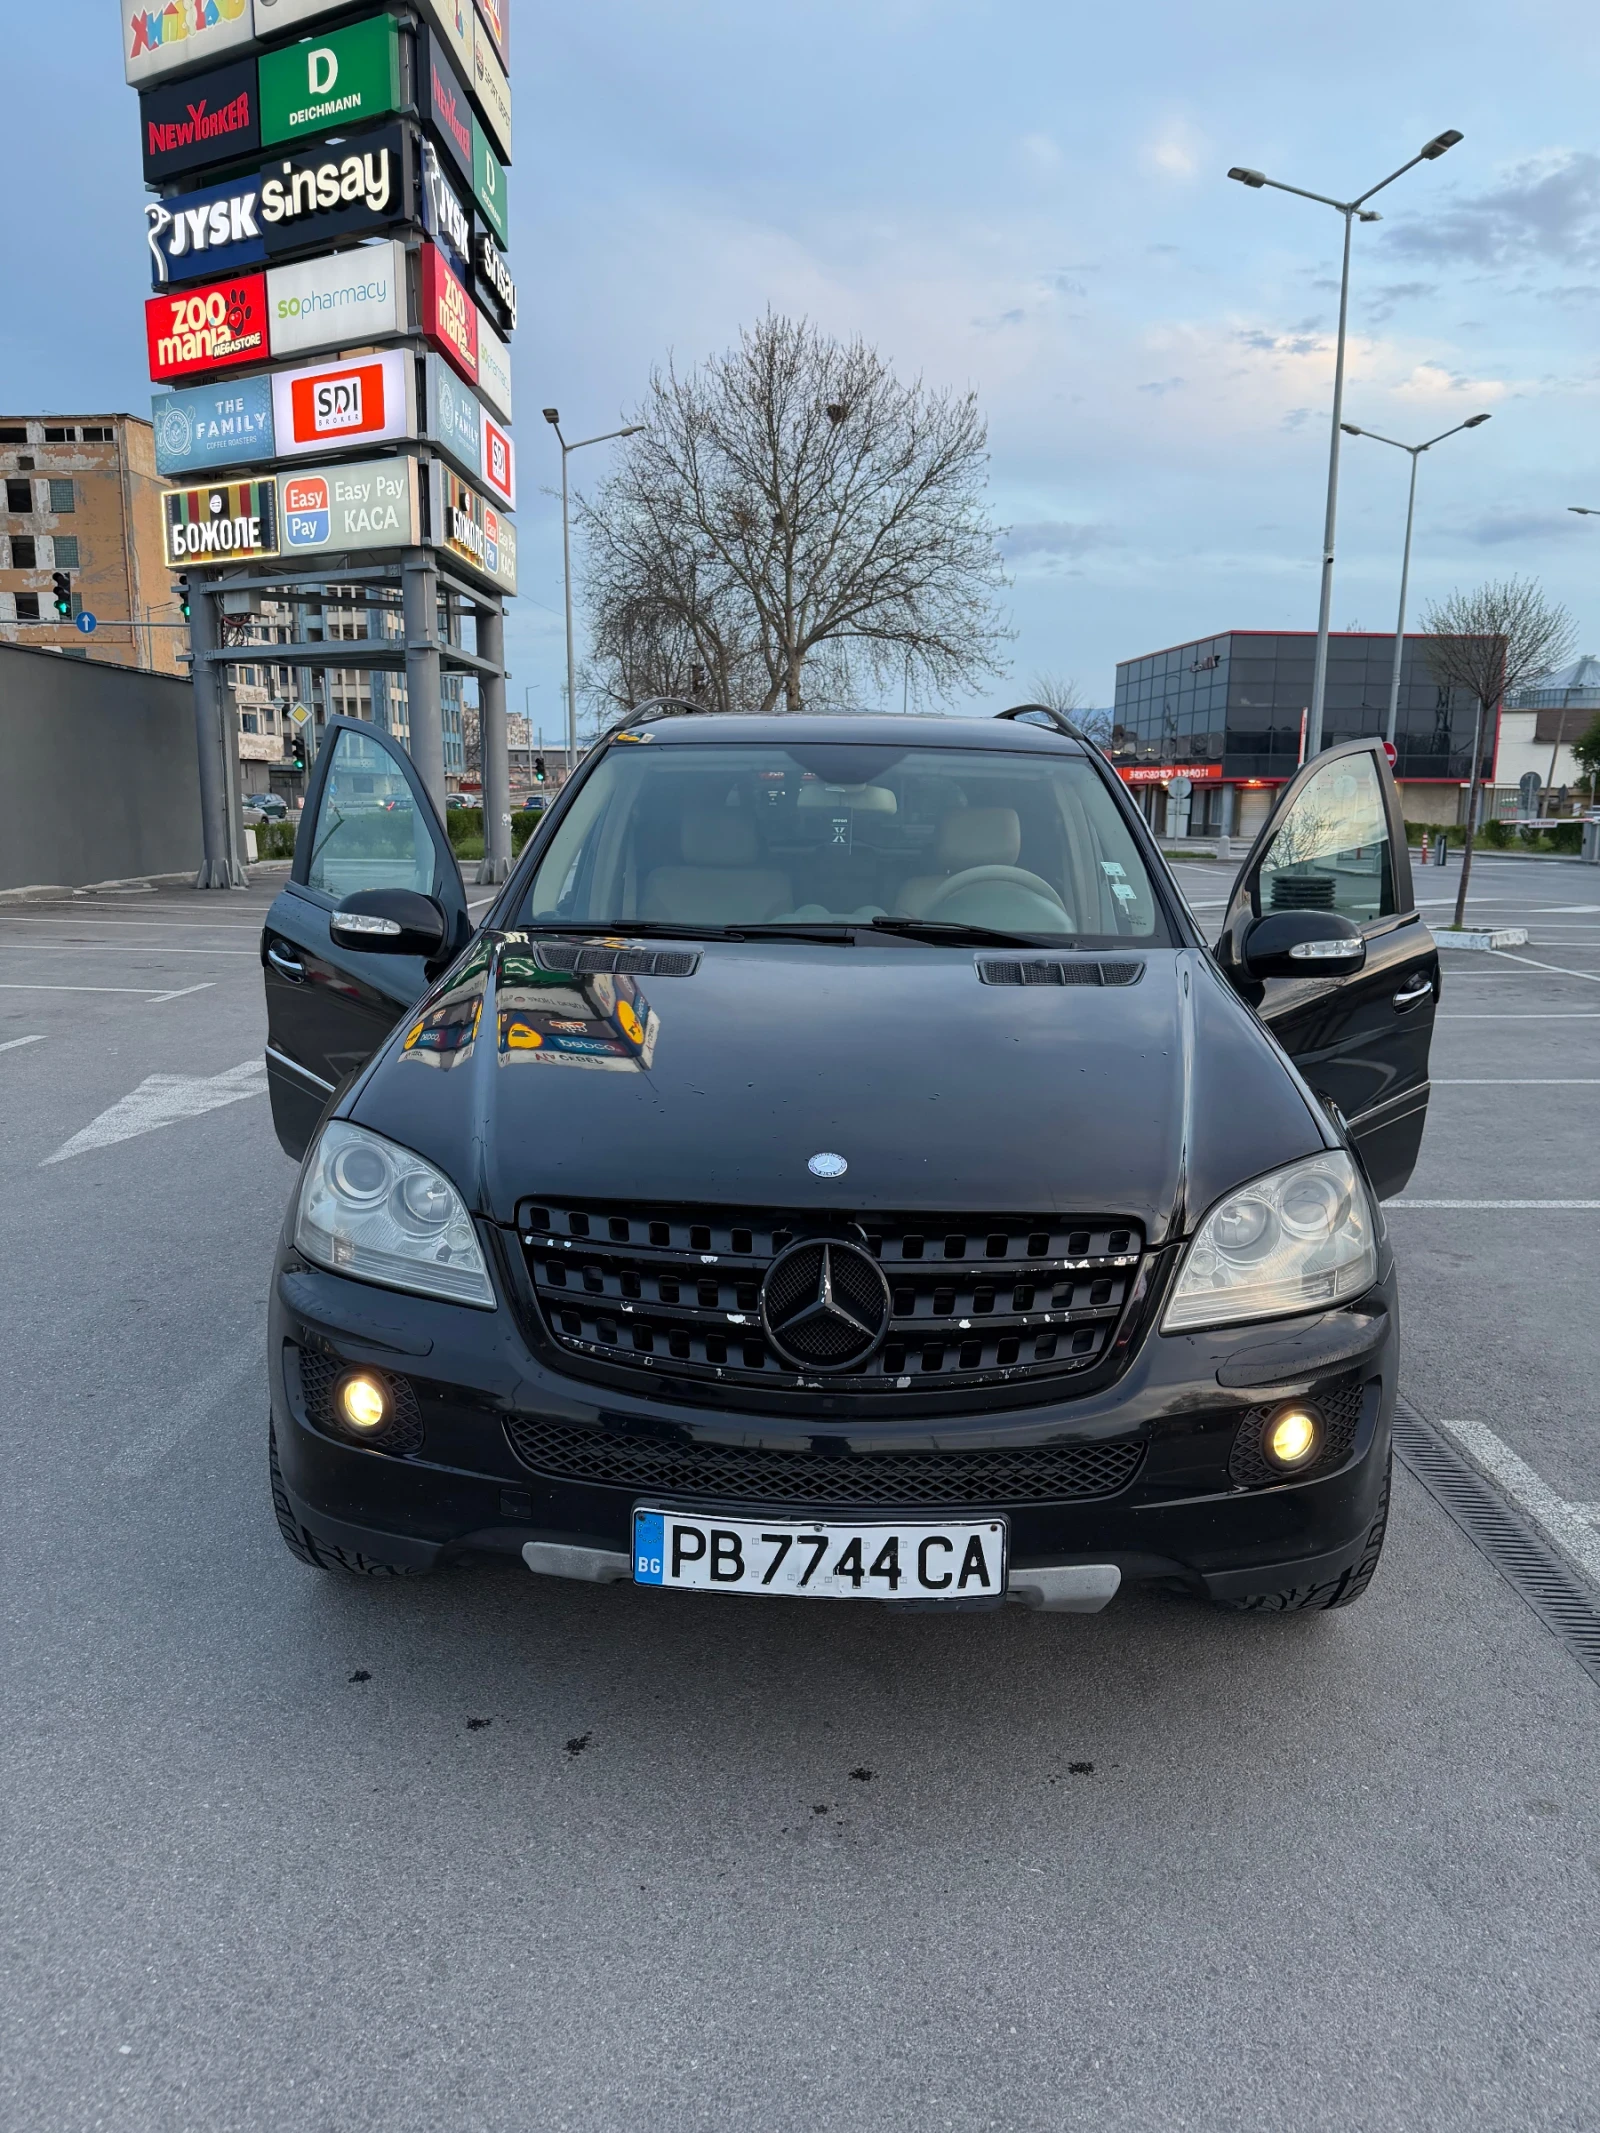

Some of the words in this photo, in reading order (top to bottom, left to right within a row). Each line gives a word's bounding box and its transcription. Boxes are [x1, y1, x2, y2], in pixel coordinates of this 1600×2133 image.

[307, 48, 338, 94] D
[289, 93, 362, 126] DEICHMANN
[262, 148, 390, 222] sinsay
[169, 192, 261, 256] JYSK
[440, 180, 470, 265] JYSK
[485, 233, 517, 330] sinsay
[277, 280, 387, 320] sopharmacy
[158, 325, 231, 366] mania
[213, 332, 262, 358] MEGASTORE
[215, 398, 244, 415] THE
[318, 383, 358, 417] SDI
[461, 400, 472, 420] THE
[196, 412, 267, 439] FAMILY
[318, 414, 359, 426] BROKER
[455, 410, 478, 446] FAMILY
[206, 440, 228, 450] COFFEE
[228, 435, 257, 447] ROASTERS
[290, 489, 323, 509] Easy
[335, 481, 371, 502] Easy
[376, 476, 404, 499] Pay
[292, 517, 317, 539] Pay
[344, 505, 400, 533] КАСА
[452, 506, 484, 560] БОЖОЛЕ
[172, 517, 262, 556] БОЖОЛЕ
[638, 1556, 661, 1574] BG
[761, 1533, 902, 1591] 7744
